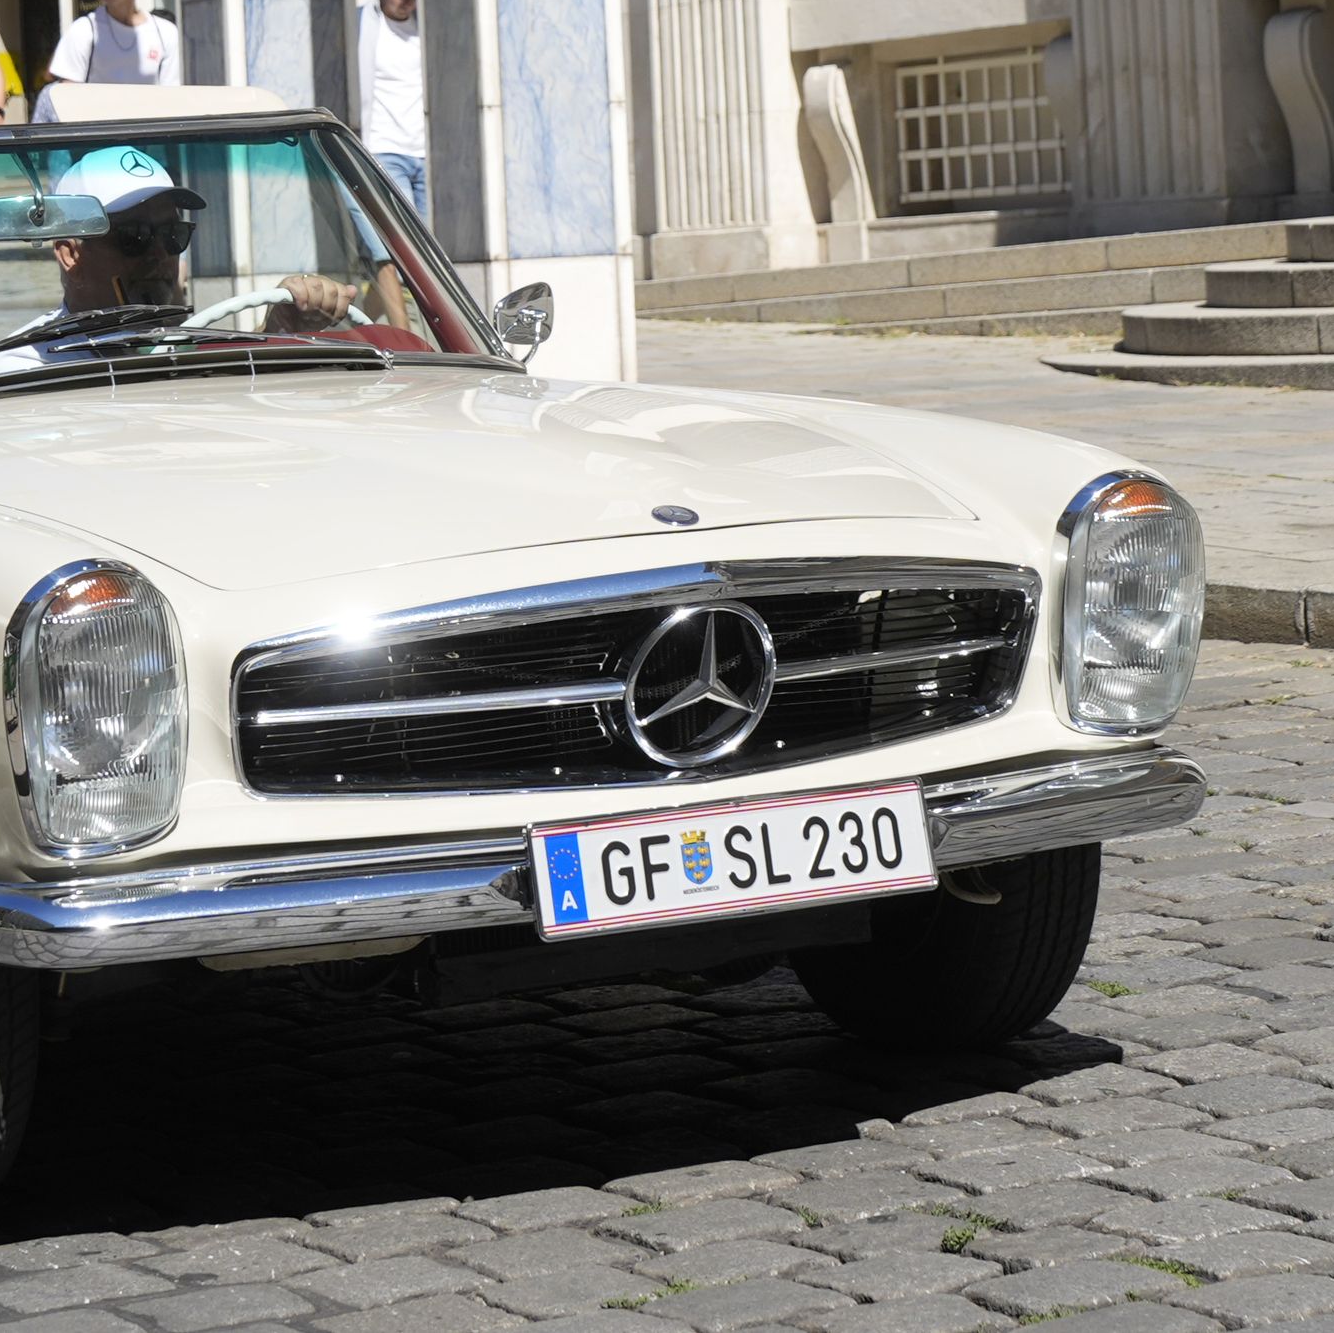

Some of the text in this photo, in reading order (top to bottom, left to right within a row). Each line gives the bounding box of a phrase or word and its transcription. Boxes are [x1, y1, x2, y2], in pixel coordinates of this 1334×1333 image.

[561, 806, 903, 912] A GF SL 230
